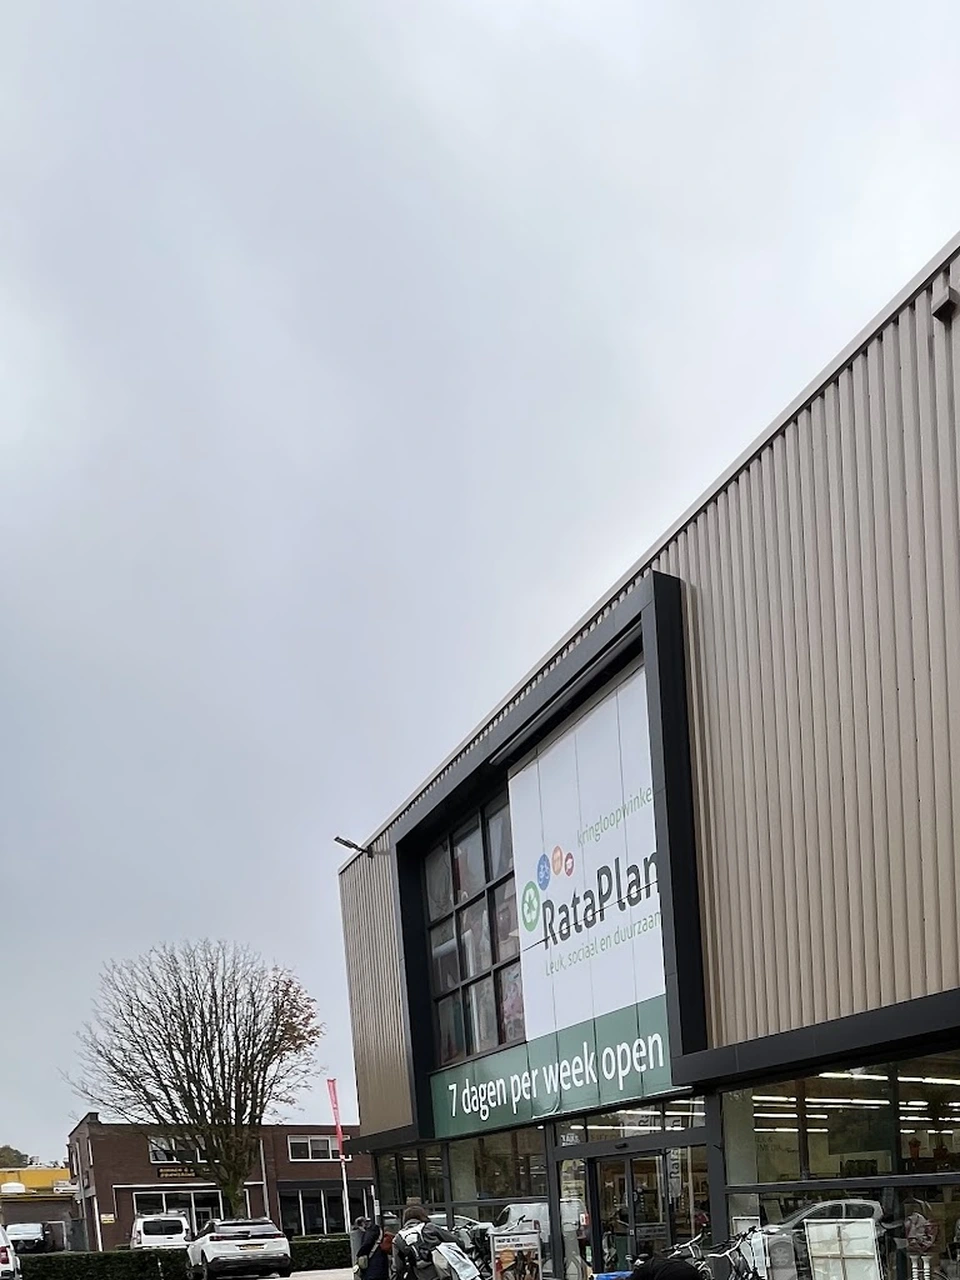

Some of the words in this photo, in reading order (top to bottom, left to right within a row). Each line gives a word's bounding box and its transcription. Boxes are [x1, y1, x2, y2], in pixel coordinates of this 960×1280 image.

[576, 786, 653, 847] kringloopwinke
[541, 852, 660, 951] RataPlan
[568, 942, 599, 966] sociaal
[600, 933, 612, 952] en
[448, 1083, 458, 1117] 7
[461, 1077, 507, 1121] dagen
[510, 1067, 538, 1114] per
[542, 1041, 598, 1095] week
[602, 1032, 664, 1091] open
